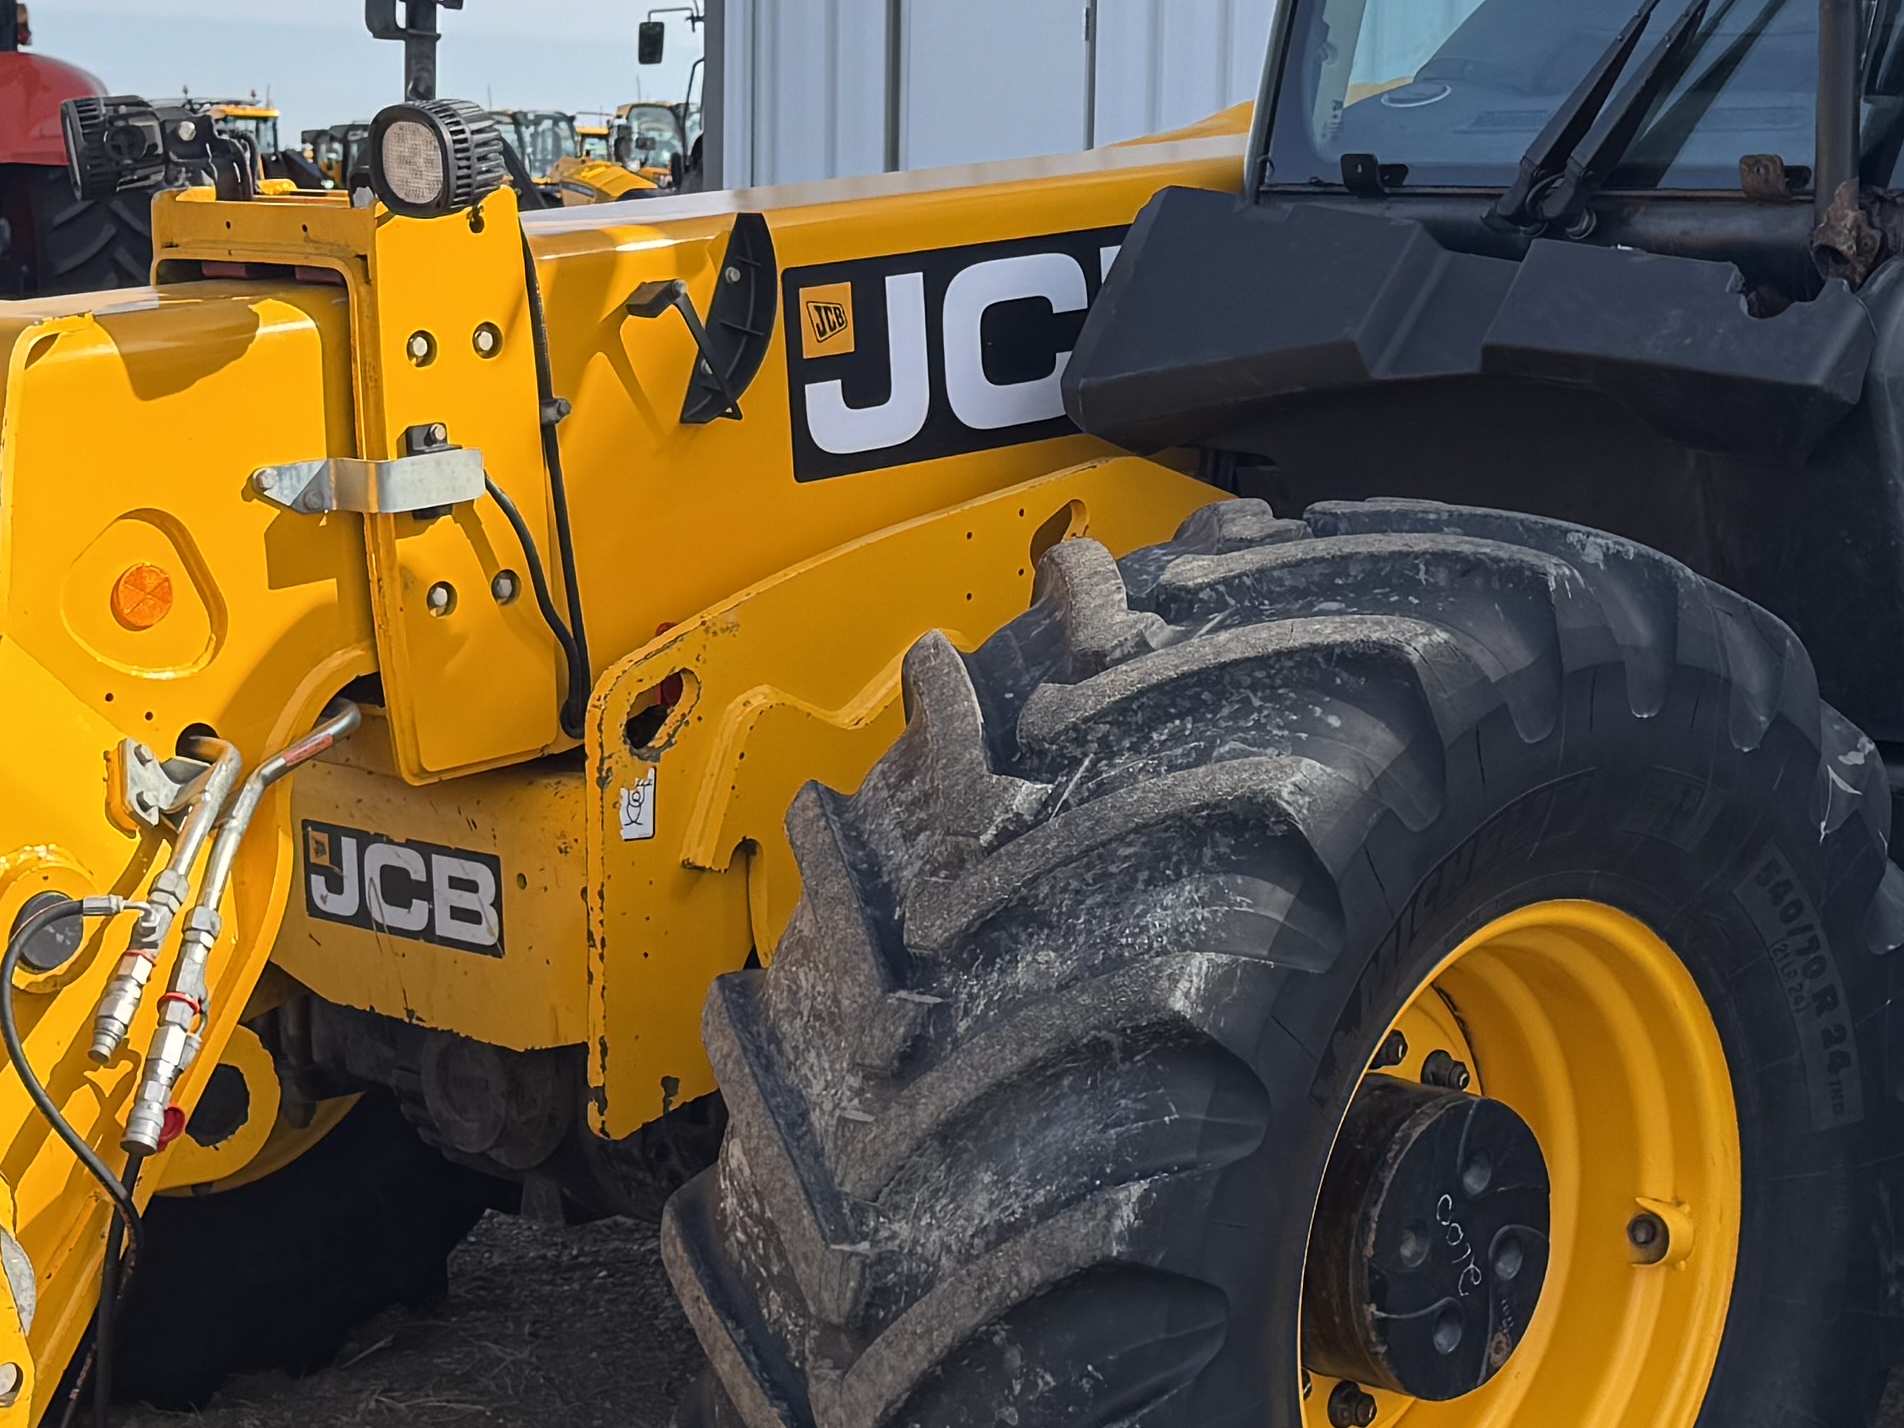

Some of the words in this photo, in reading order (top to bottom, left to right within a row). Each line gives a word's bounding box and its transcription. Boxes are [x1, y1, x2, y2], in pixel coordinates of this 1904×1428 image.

[805, 244, 1122, 455] JC
[812, 304, 846, 339] JCB
[310, 836, 500, 946] JCB
